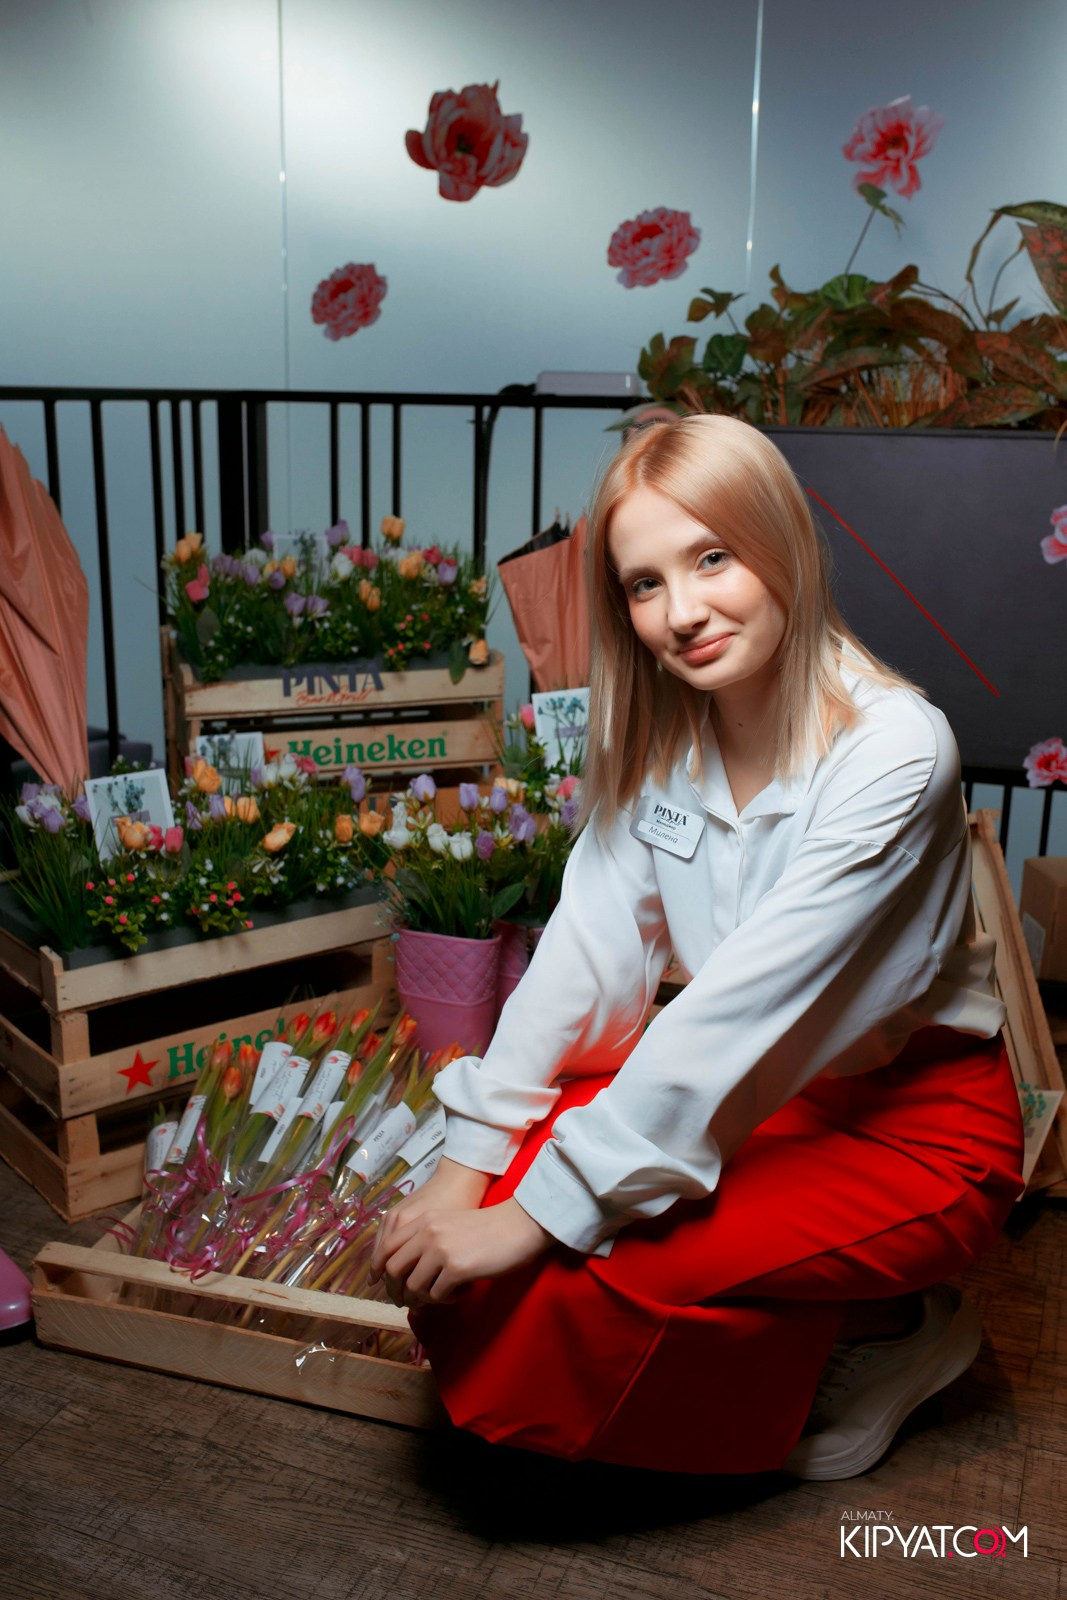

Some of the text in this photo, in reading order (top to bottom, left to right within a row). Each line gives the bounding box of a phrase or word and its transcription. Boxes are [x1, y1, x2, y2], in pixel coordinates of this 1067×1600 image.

[282, 662, 384, 697] PINTA
[288, 733, 448, 766] Heineken
[653, 804, 688, 827] PINTA
[648, 826, 679, 844] Милена
